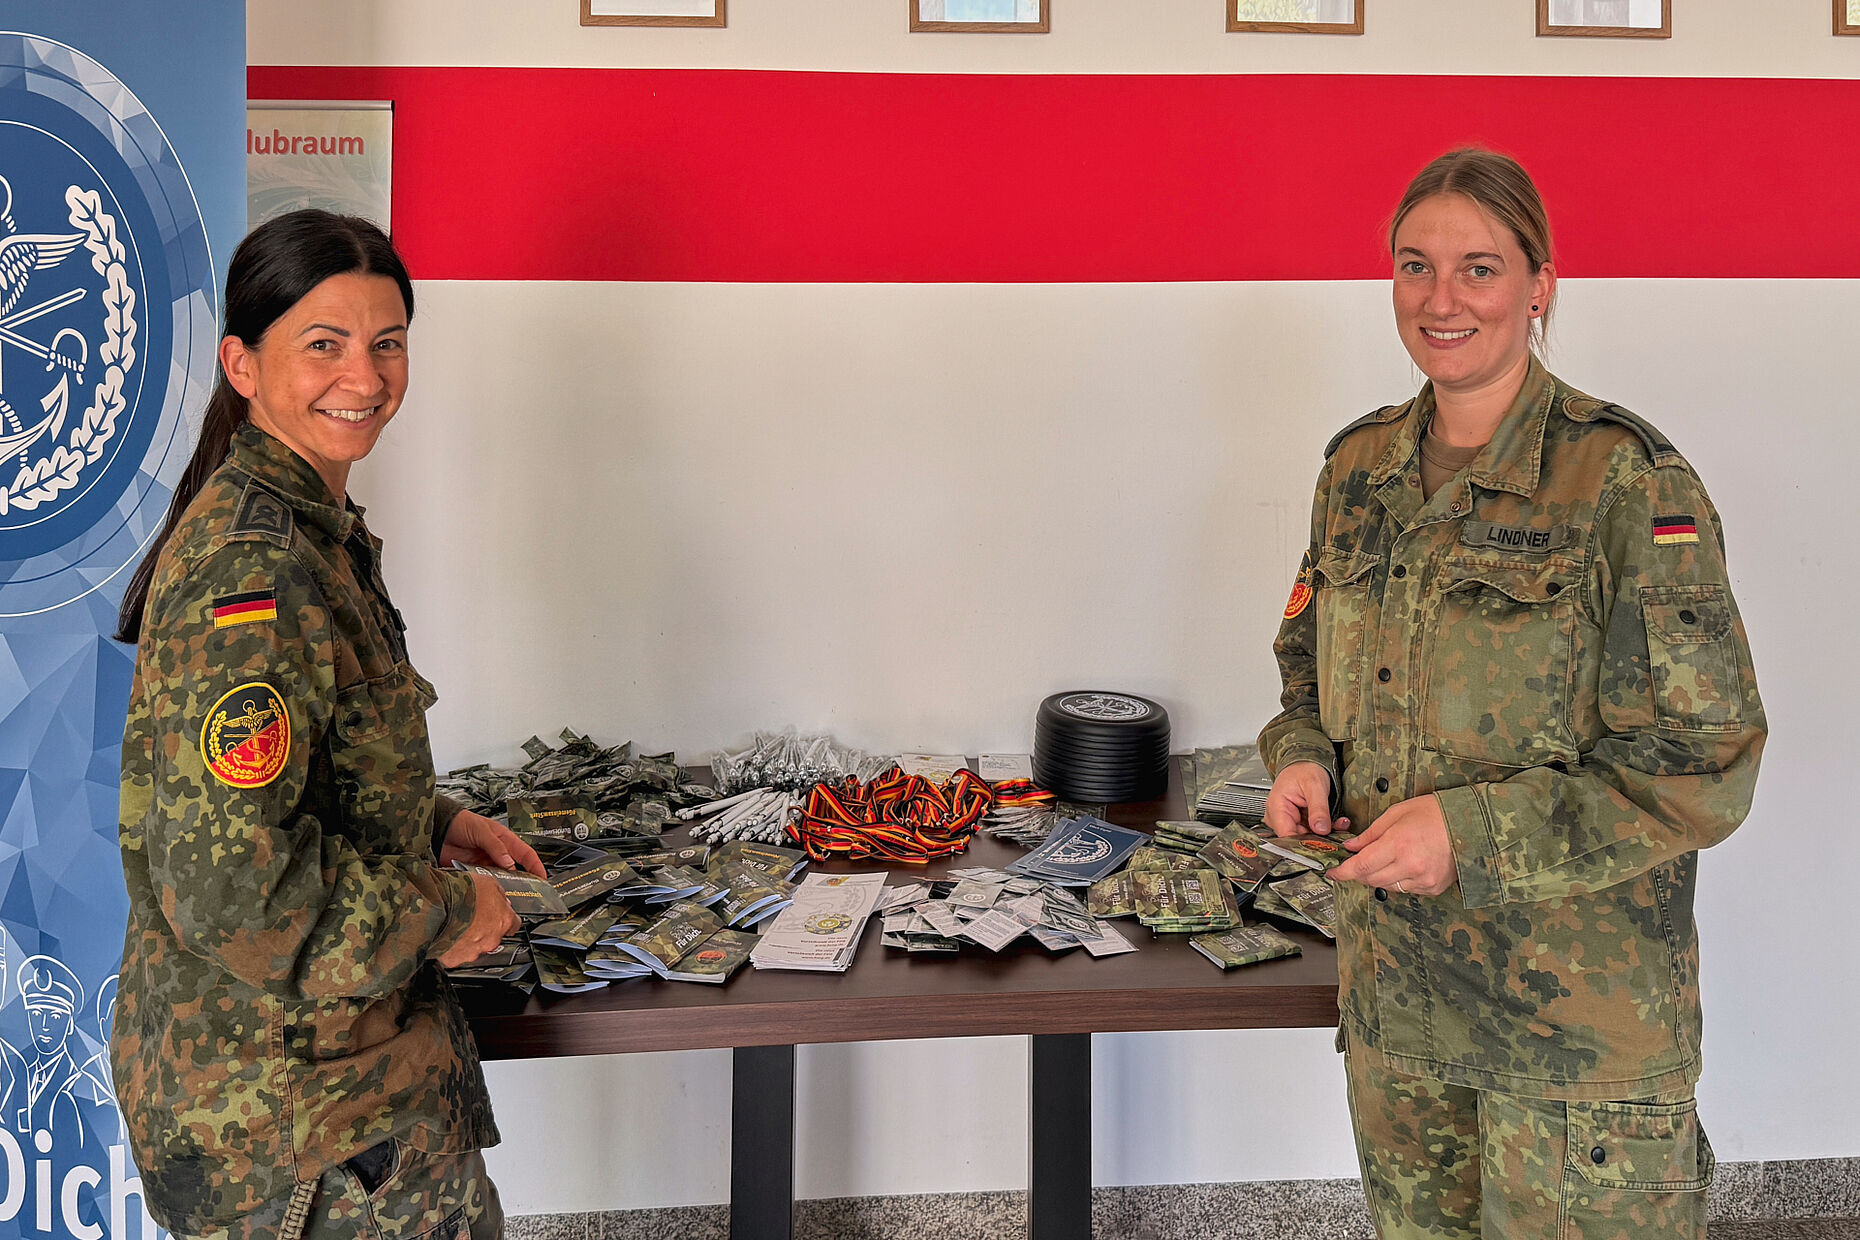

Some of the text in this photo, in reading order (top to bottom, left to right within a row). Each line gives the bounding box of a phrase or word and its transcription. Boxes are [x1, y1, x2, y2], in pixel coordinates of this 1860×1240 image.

[1487, 526, 1550, 547] LINDNER
[1158, 875, 1170, 908] Für Dich.
[1297, 890, 1311, 902] Für
[675, 936, 689, 949] Für
[685, 928, 702, 943] Dich.
